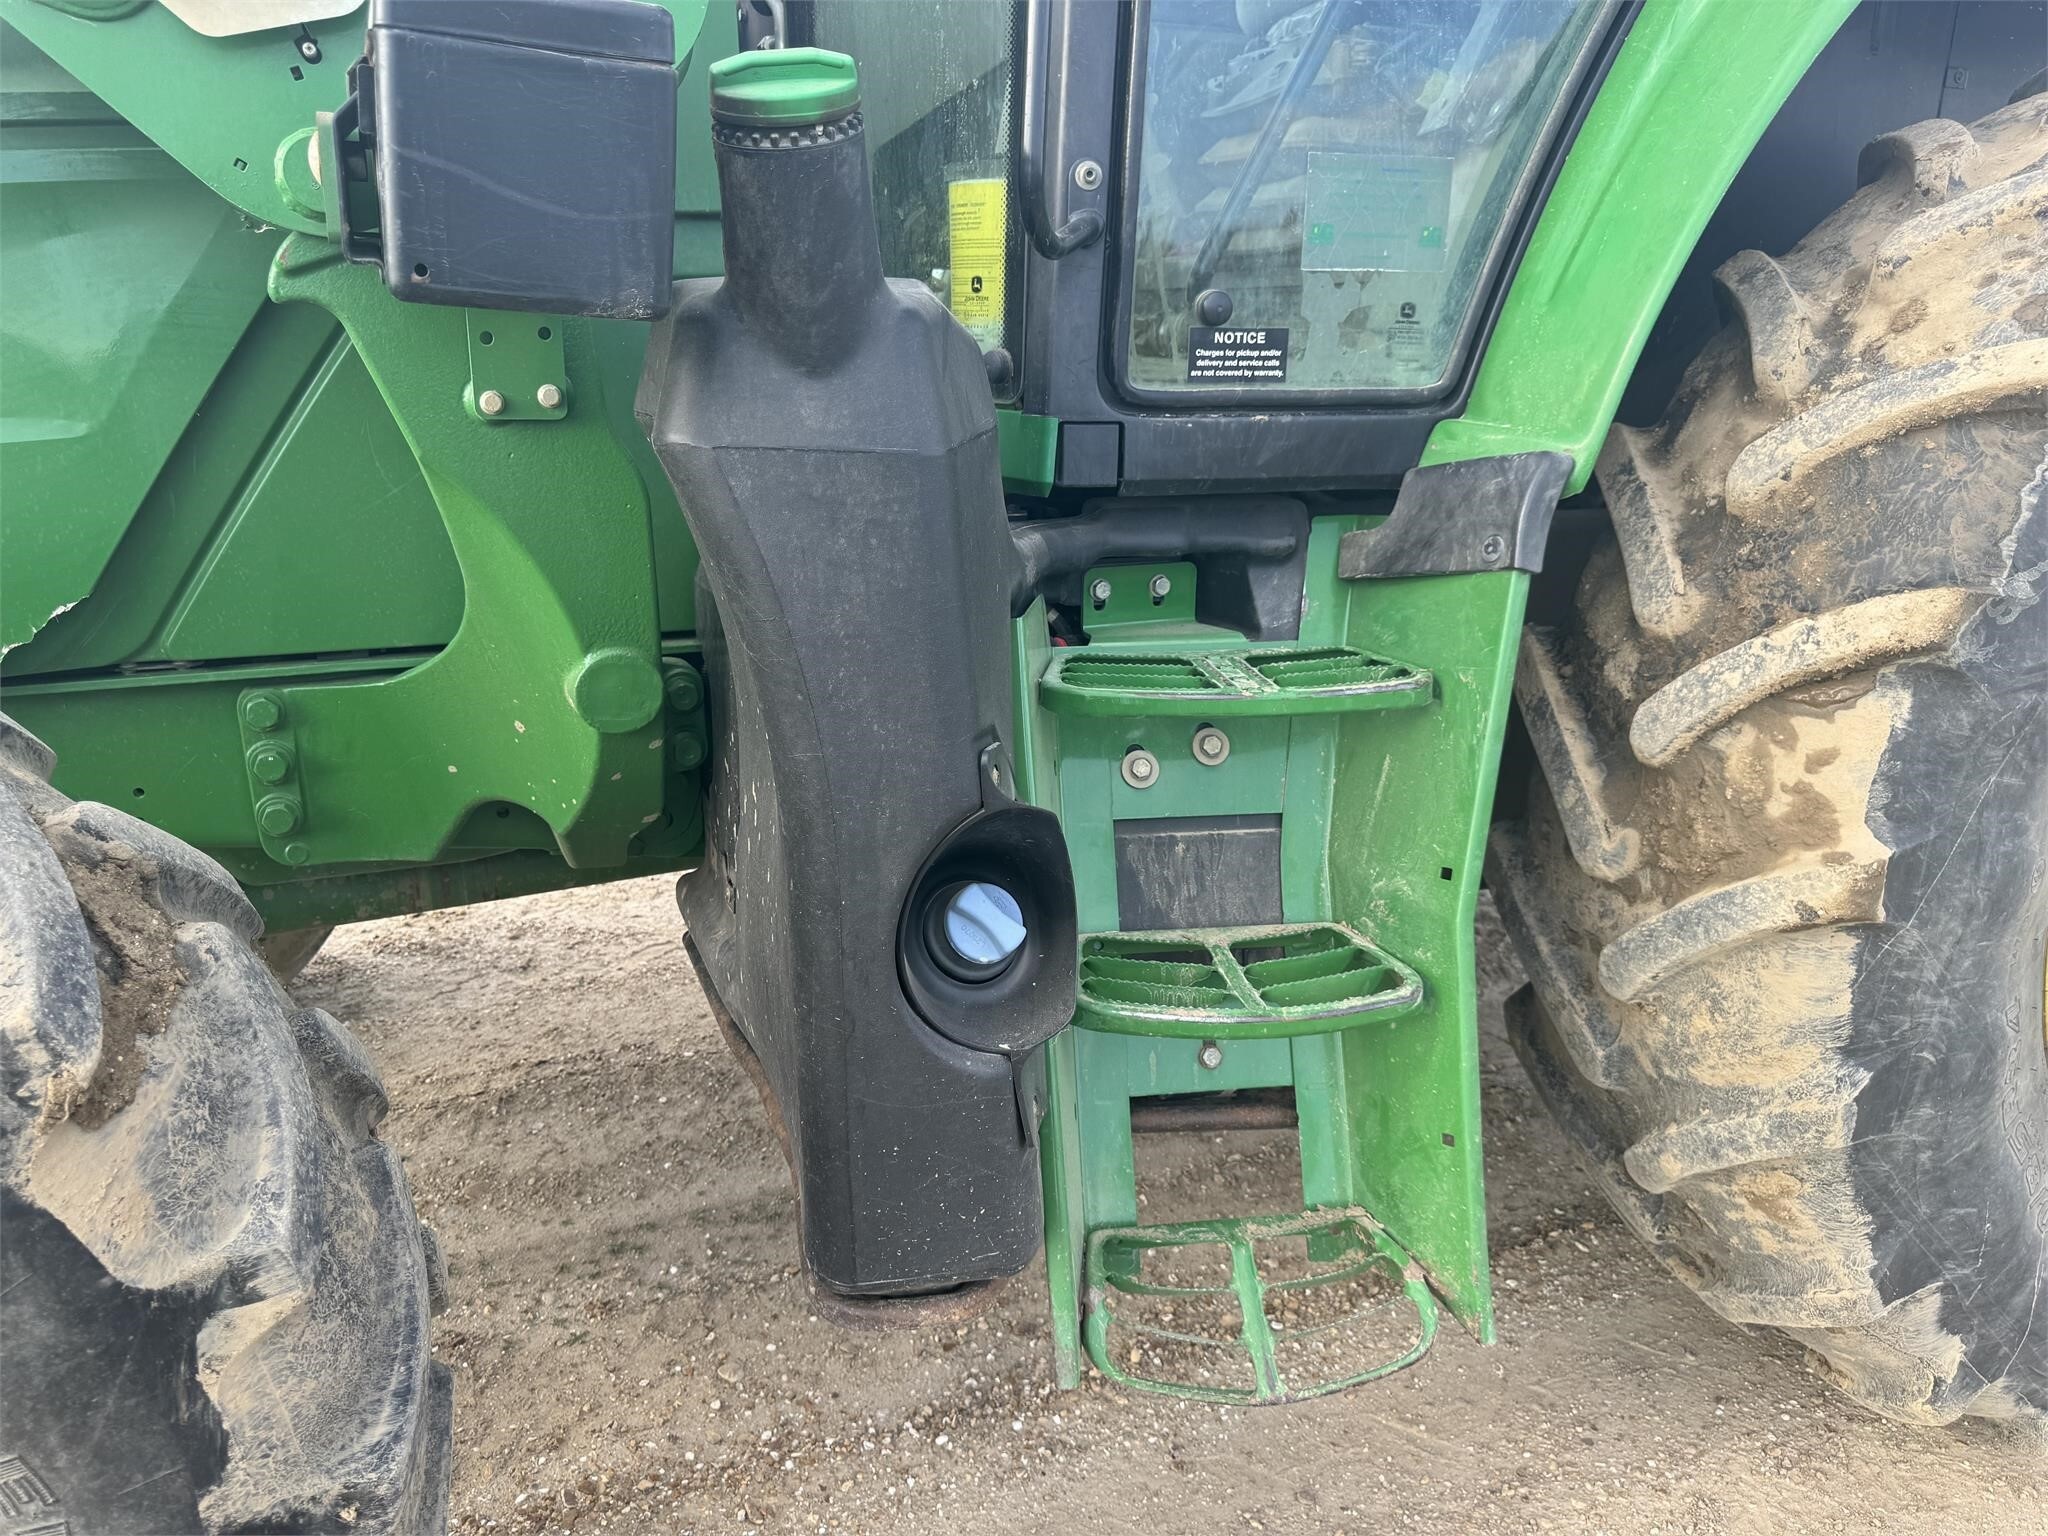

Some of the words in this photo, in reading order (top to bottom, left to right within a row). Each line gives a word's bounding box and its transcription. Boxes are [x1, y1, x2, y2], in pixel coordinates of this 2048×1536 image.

[1215, 332, 1266, 344] NOTICE
[1196, 349, 1224, 357] Charges
[1236, 349, 1259, 357] pickup
[1196, 359, 1223, 367] delivery
